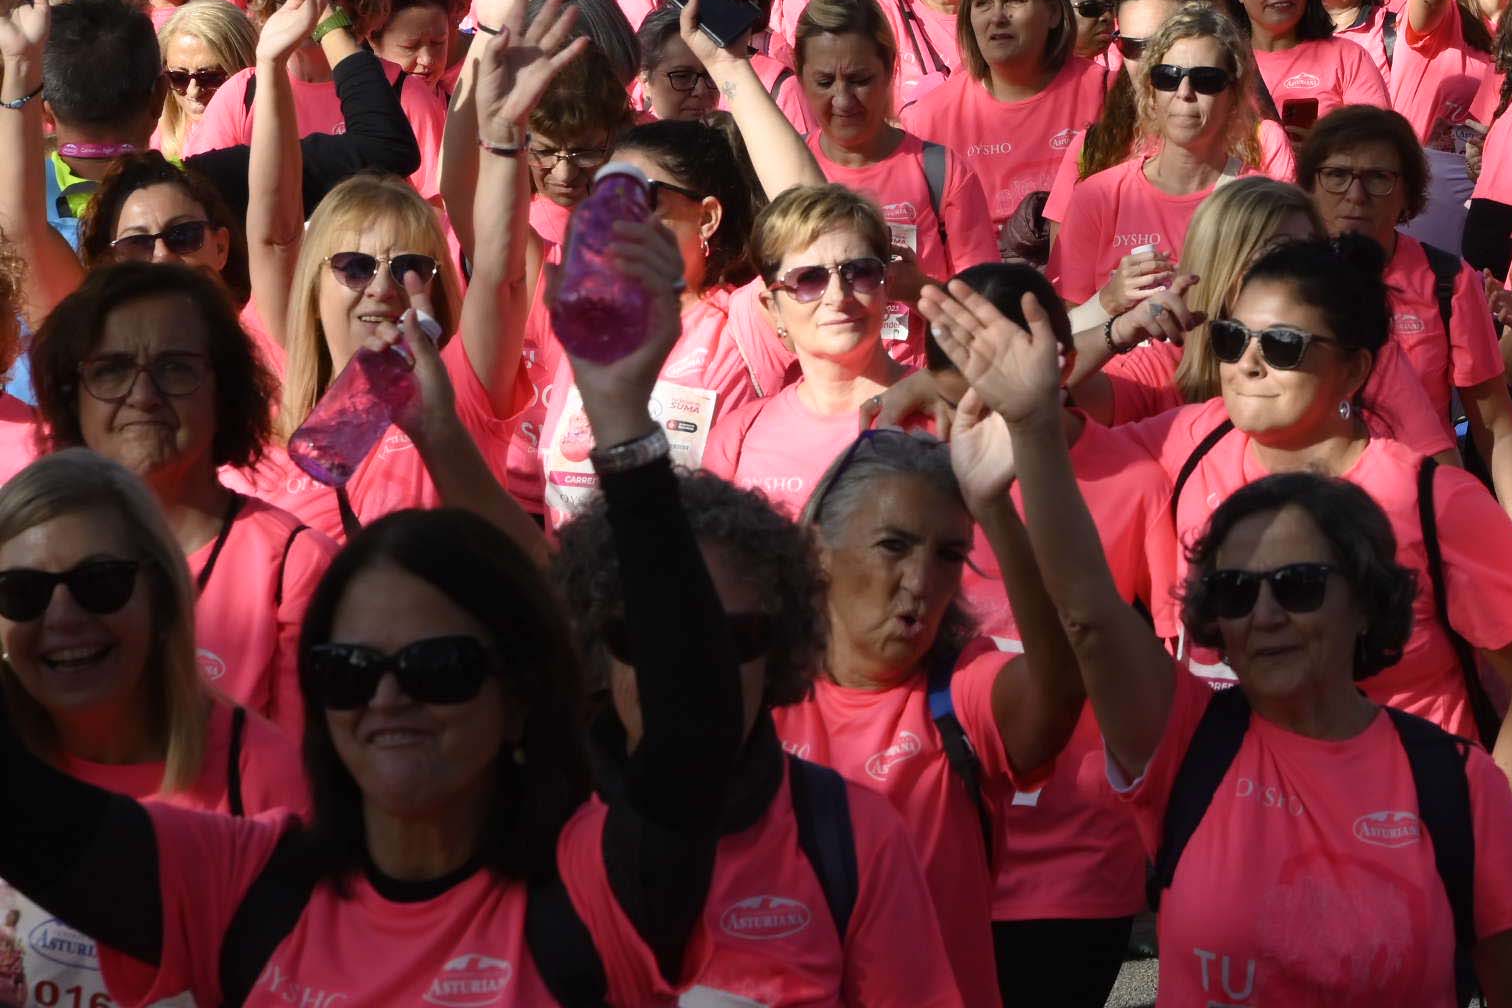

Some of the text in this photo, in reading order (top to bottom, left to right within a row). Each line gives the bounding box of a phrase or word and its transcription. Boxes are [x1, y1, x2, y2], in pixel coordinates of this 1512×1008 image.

[967, 142, 1012, 157] OYSHO
[1112, 232, 1161, 248] OYSHO
[1193, 947, 1256, 1001] TU
